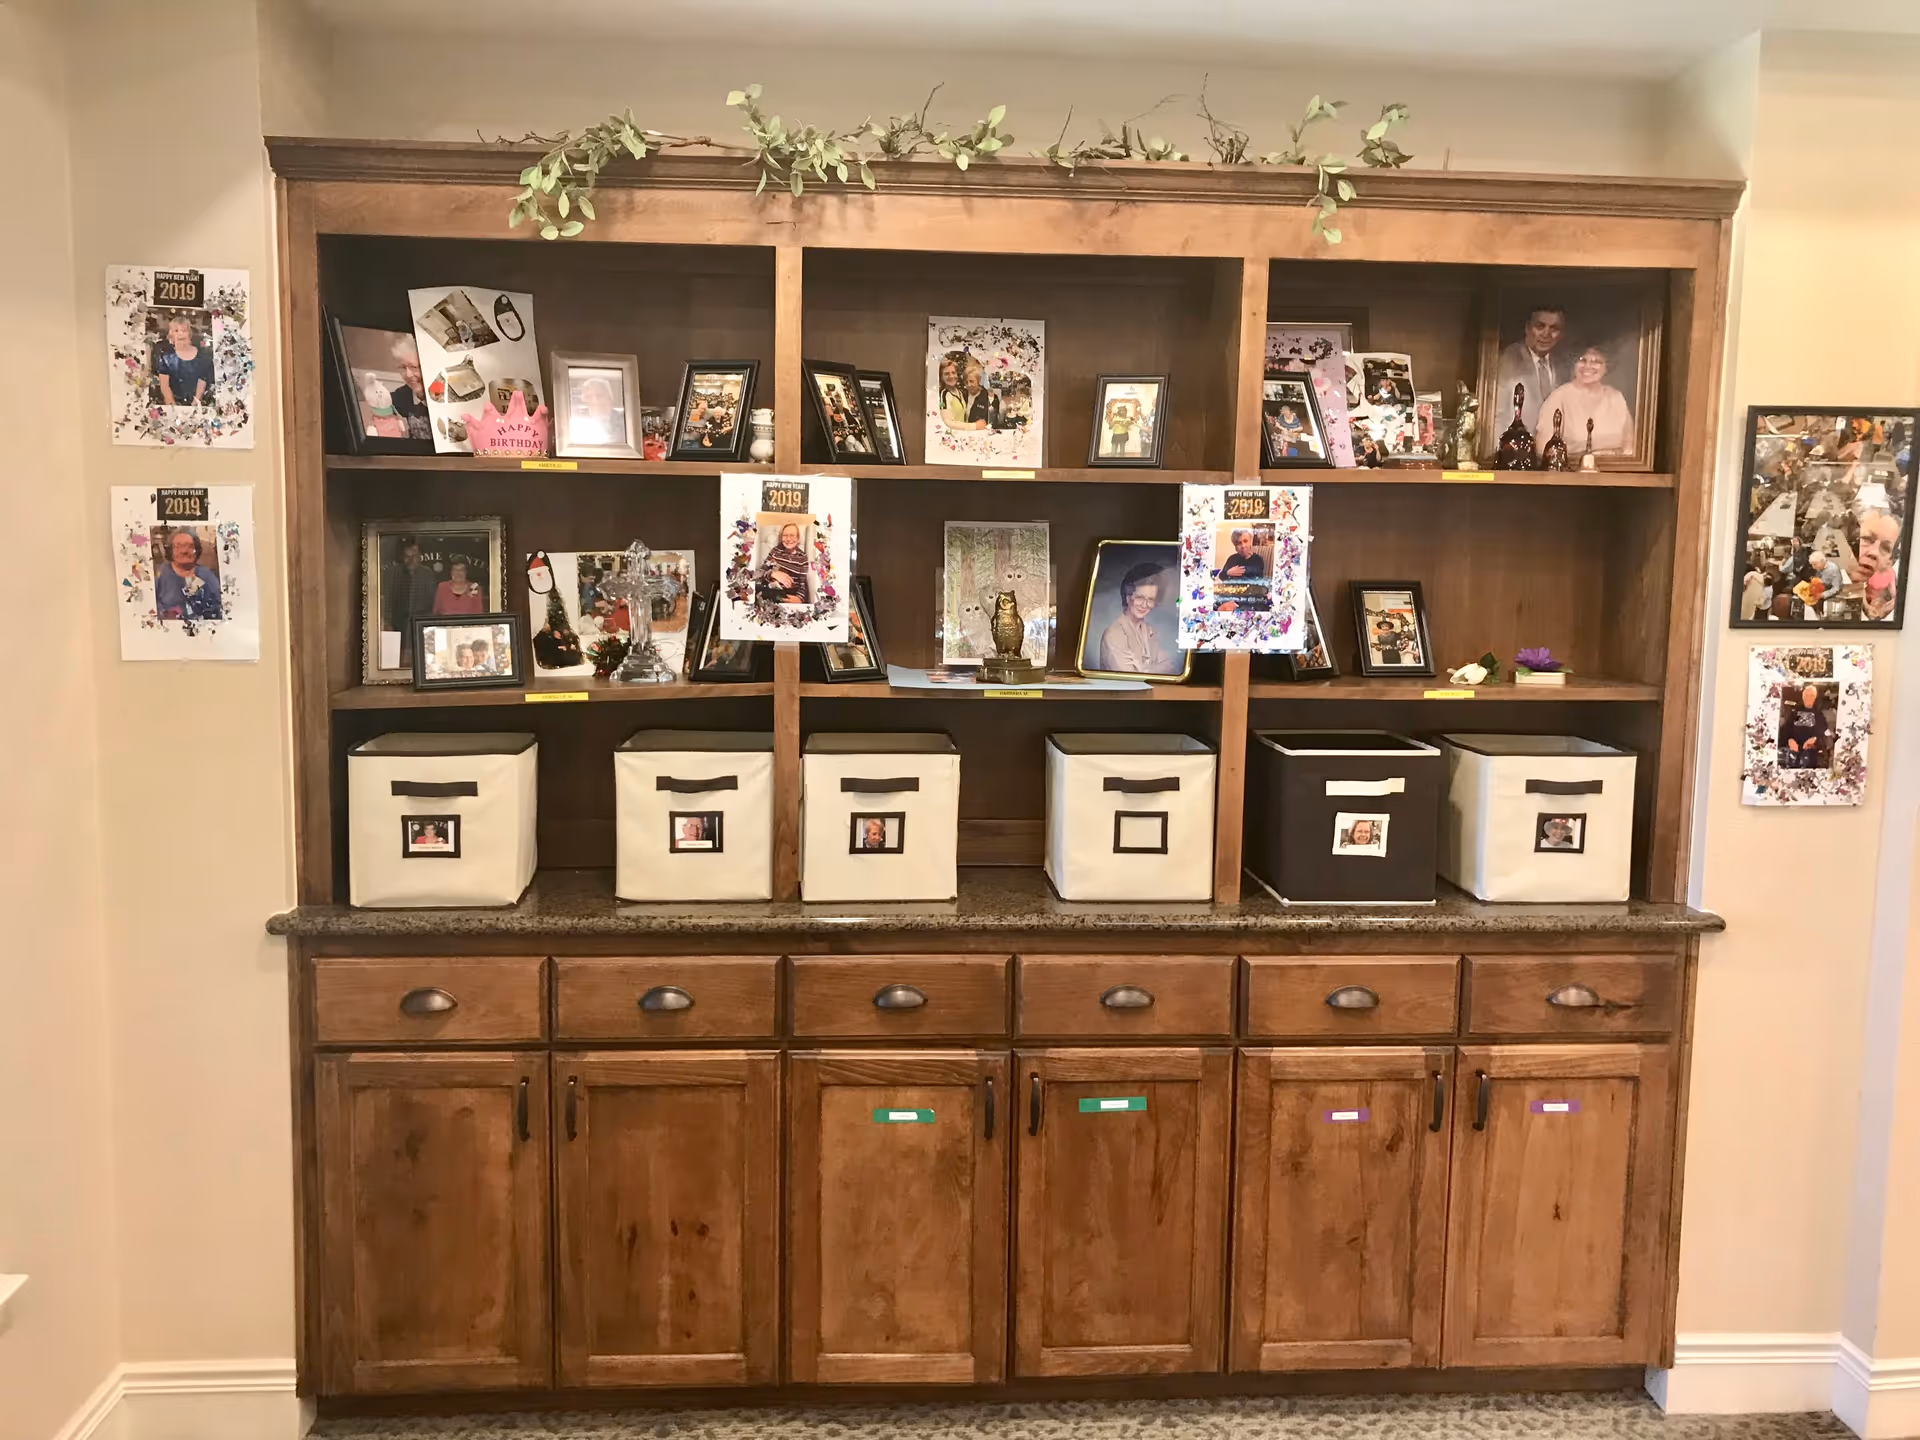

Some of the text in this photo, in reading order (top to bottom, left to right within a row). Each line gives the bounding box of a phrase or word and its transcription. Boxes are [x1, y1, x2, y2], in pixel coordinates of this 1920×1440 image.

[160, 282, 196, 300] 2019
[497, 424, 539, 438] HAPPY
[490, 438, 544, 449] BIRTHDAY
[164, 497, 201, 515] 2019
[769, 489, 802, 508] 2019
[1230, 498, 1264, 516] 2019
[420, 552, 442, 562] OME
[1796, 656, 1826, 672] 2019
